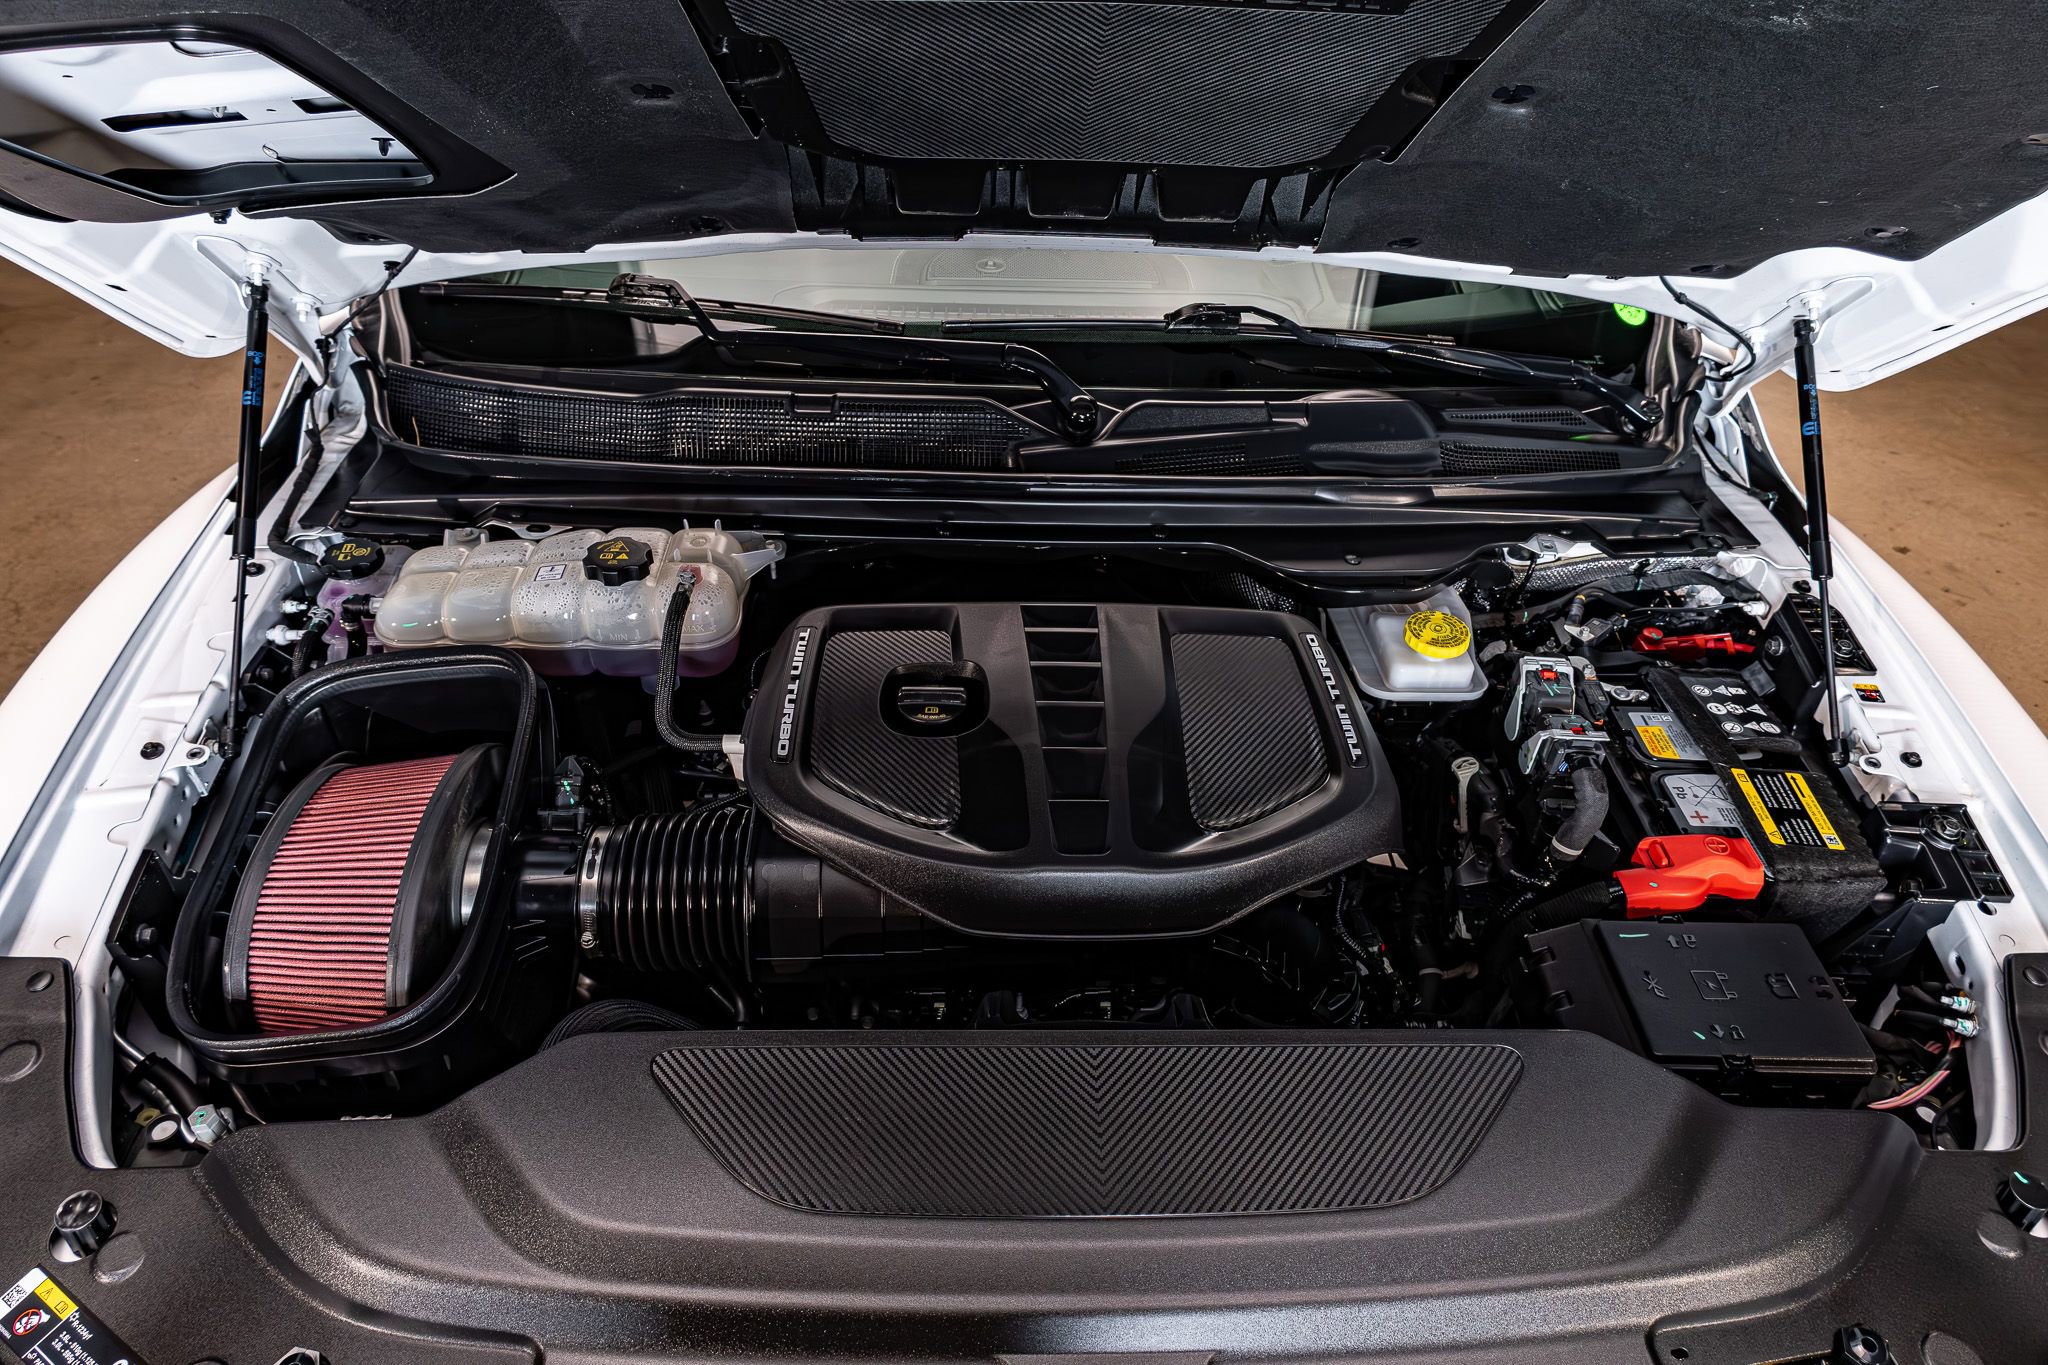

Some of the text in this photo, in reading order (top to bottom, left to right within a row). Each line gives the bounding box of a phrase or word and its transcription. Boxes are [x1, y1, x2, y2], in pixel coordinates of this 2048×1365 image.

[683, 625, 705, 633] MAX
[609, 633, 628, 641] MIN
[777, 628, 811, 756] TWIN TURBO
[1306, 634, 1362, 762] TWIN TURBO
[1672, 786, 1688, 800] Pb
